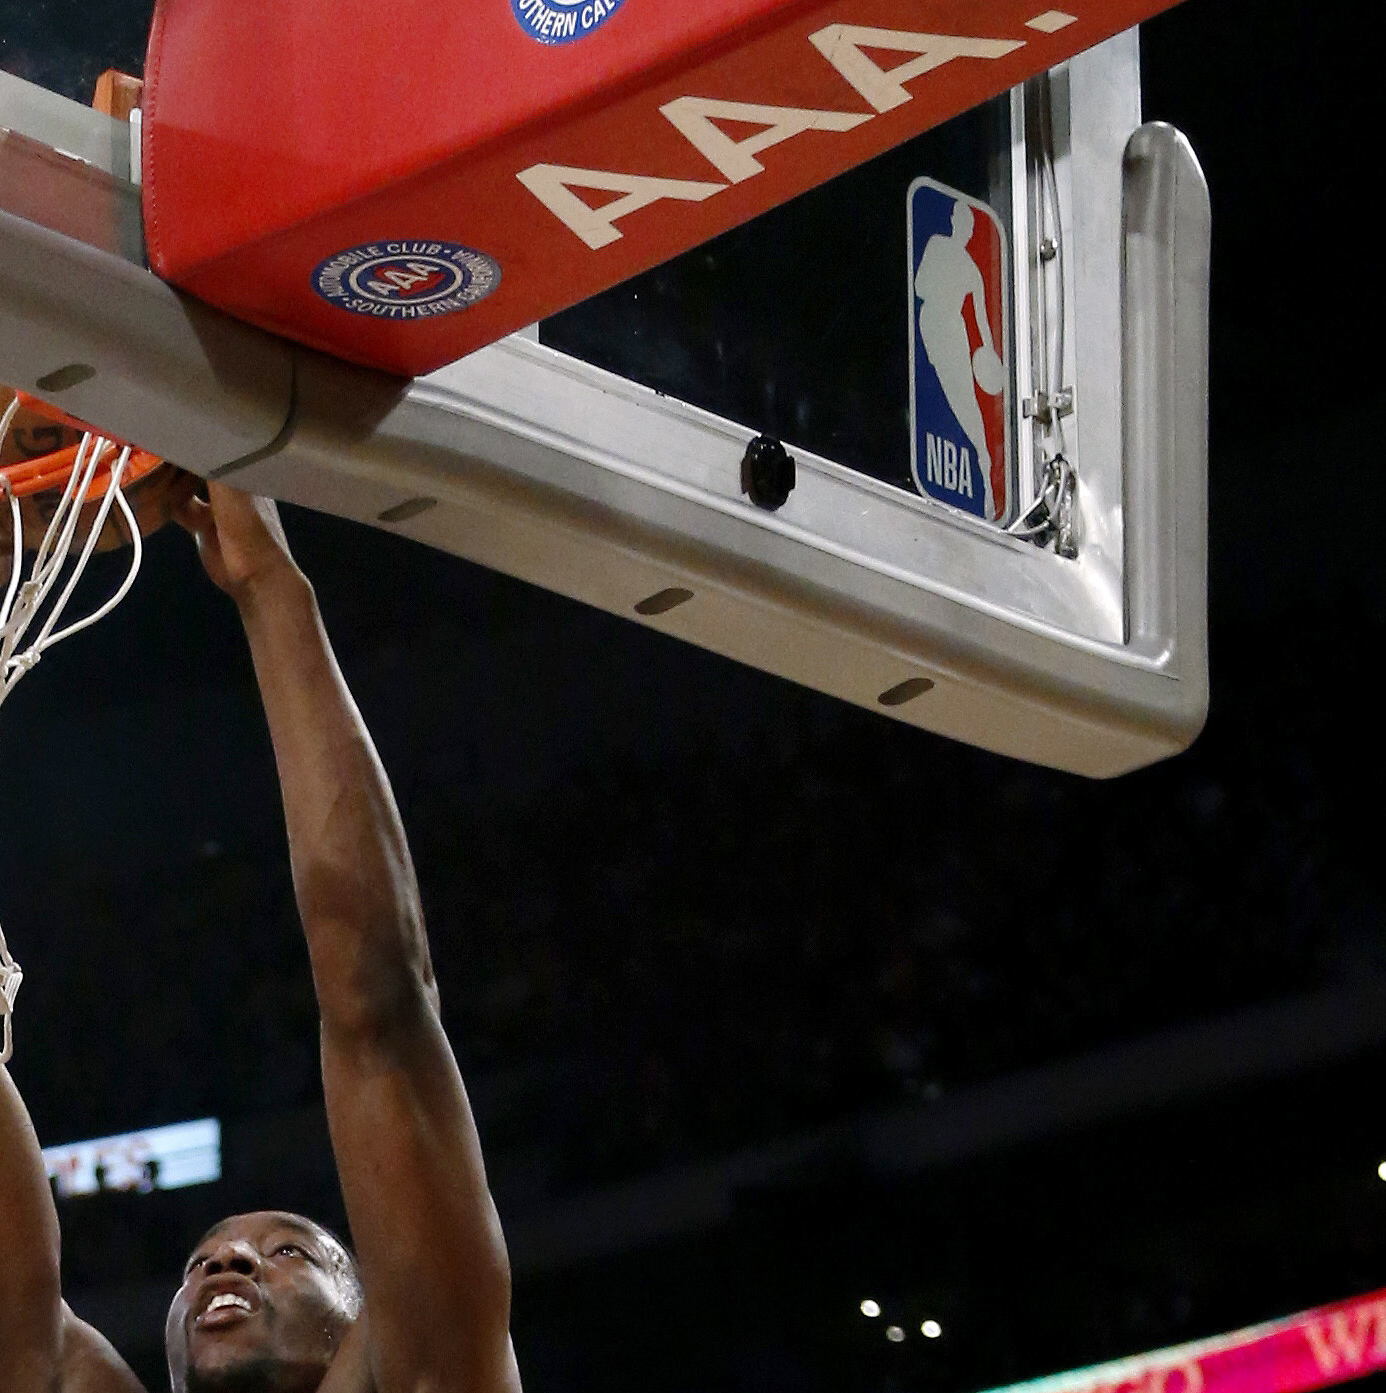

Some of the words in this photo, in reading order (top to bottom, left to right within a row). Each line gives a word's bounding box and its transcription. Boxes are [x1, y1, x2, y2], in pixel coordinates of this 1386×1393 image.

[387, 242, 443, 256] CLUB
[367, 261, 440, 297] AAA
[345, 296, 461, 318] SOUTHERN
[926, 431, 974, 499] NBA
